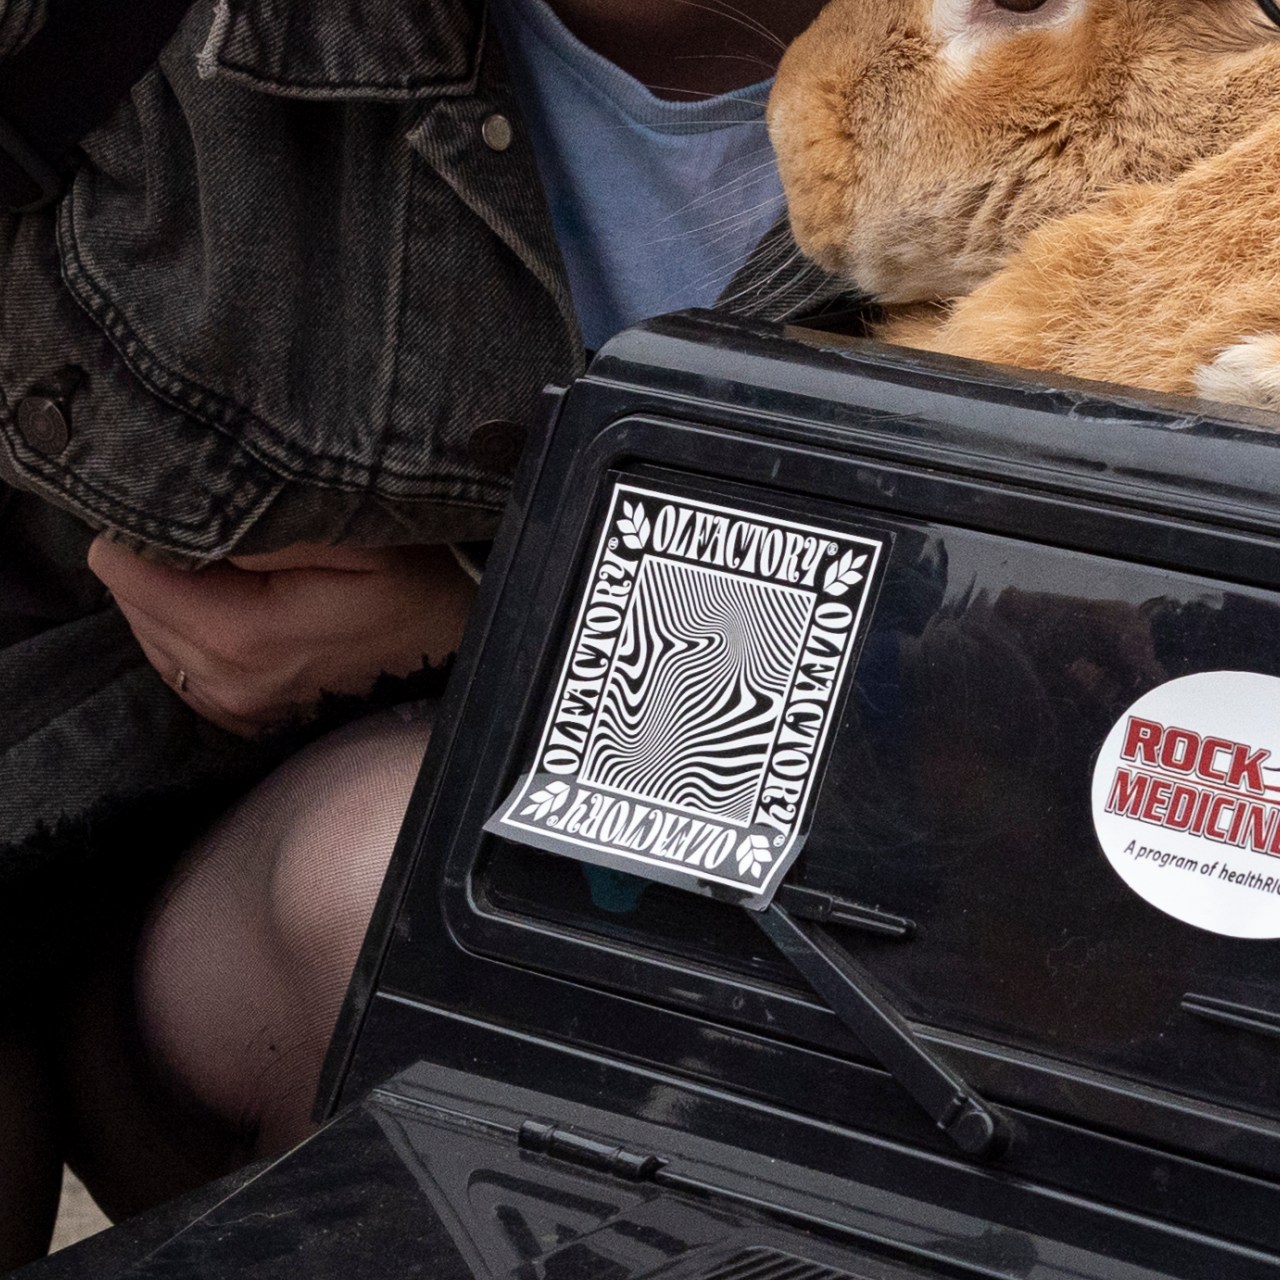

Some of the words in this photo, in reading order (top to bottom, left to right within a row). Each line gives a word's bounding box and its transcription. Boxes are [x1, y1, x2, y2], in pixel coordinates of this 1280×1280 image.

[1120, 715, 1271, 796] ROCK
[1123, 839, 1137, 855] A
[1134, 845, 1199, 872] program
[1200, 860, 1220, 877] of
